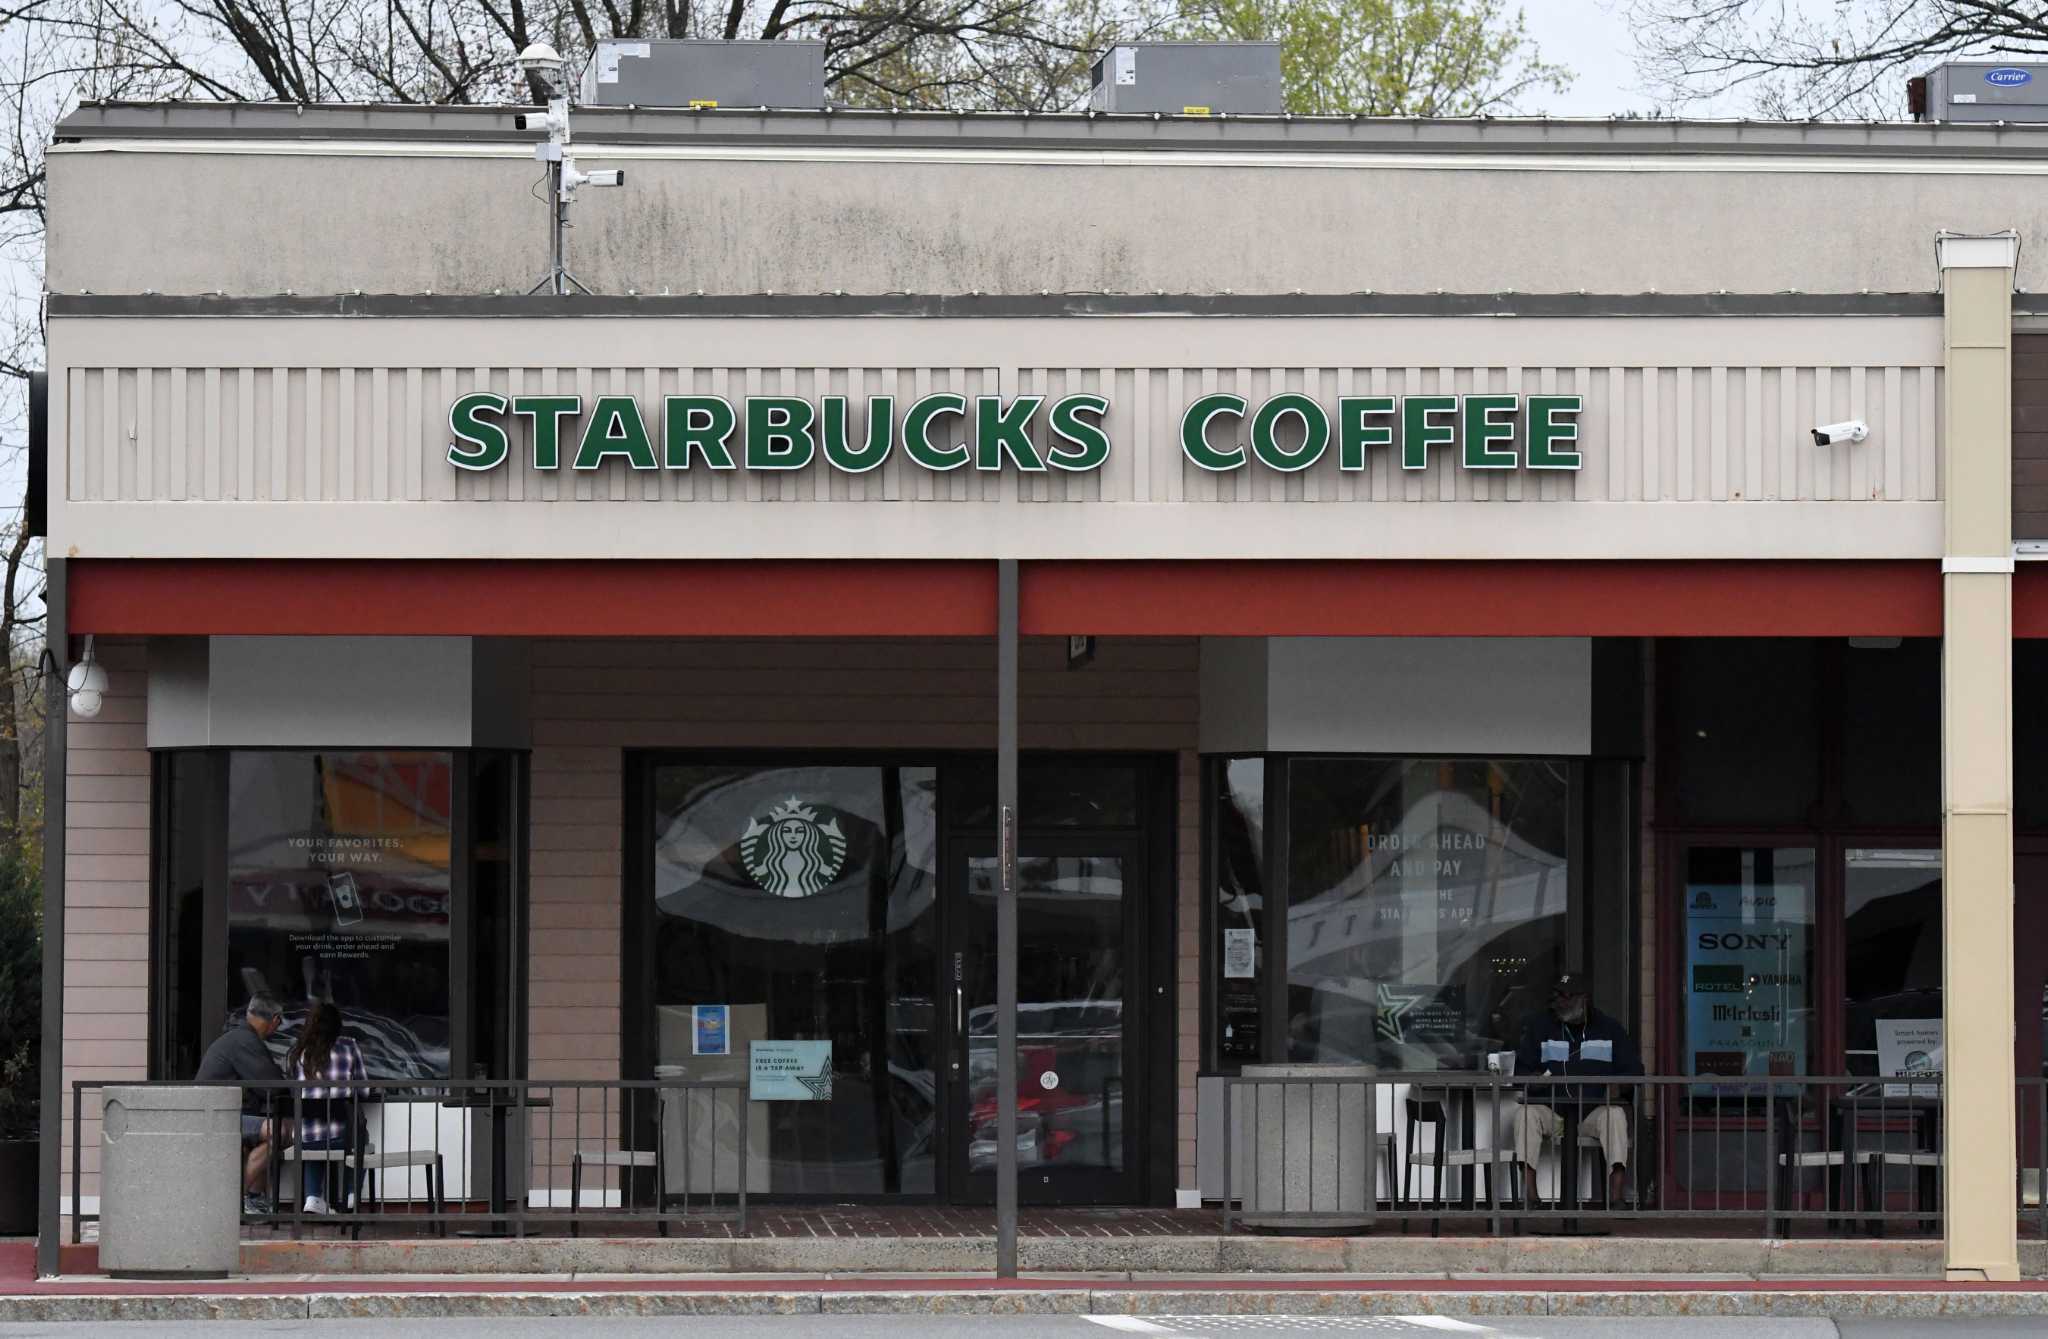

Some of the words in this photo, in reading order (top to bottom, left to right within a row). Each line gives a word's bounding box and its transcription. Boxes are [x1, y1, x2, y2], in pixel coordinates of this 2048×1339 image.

[1991, 72, 2026, 82] Carrier
[447, 393, 1111, 473] STARBUCKS
[1179, 393, 1583, 473] COFFEE
[288, 838, 324, 848] YOUR
[328, 838, 404, 848] FAVORITES.
[1430, 833, 1486, 850] AHEAD
[308, 852, 345, 863] YOUR
[350, 852, 384, 863] WAY.
[1432, 860, 1462, 877] PAY
[1698, 932, 1793, 950] SONY
